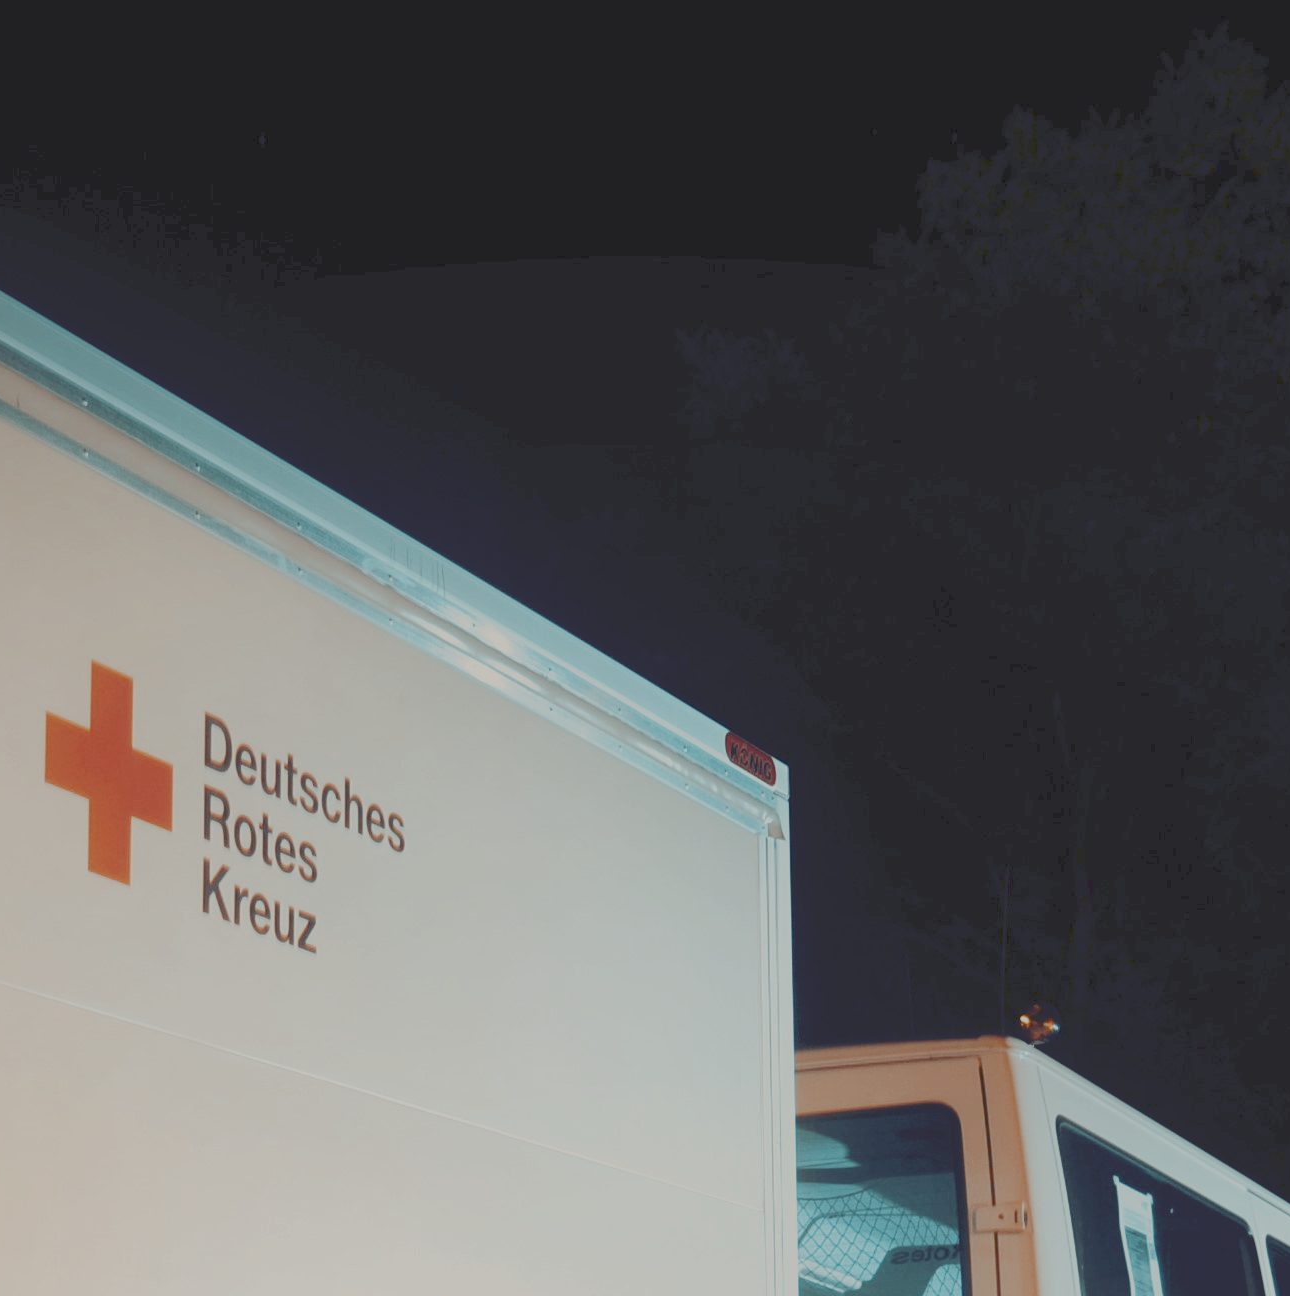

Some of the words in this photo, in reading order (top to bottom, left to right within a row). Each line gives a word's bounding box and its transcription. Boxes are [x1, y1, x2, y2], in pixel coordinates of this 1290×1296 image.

[204, 711, 406, 853] Deutsches
[203, 783, 318, 883] Rotes
[202, 856, 317, 954] Kreuz
